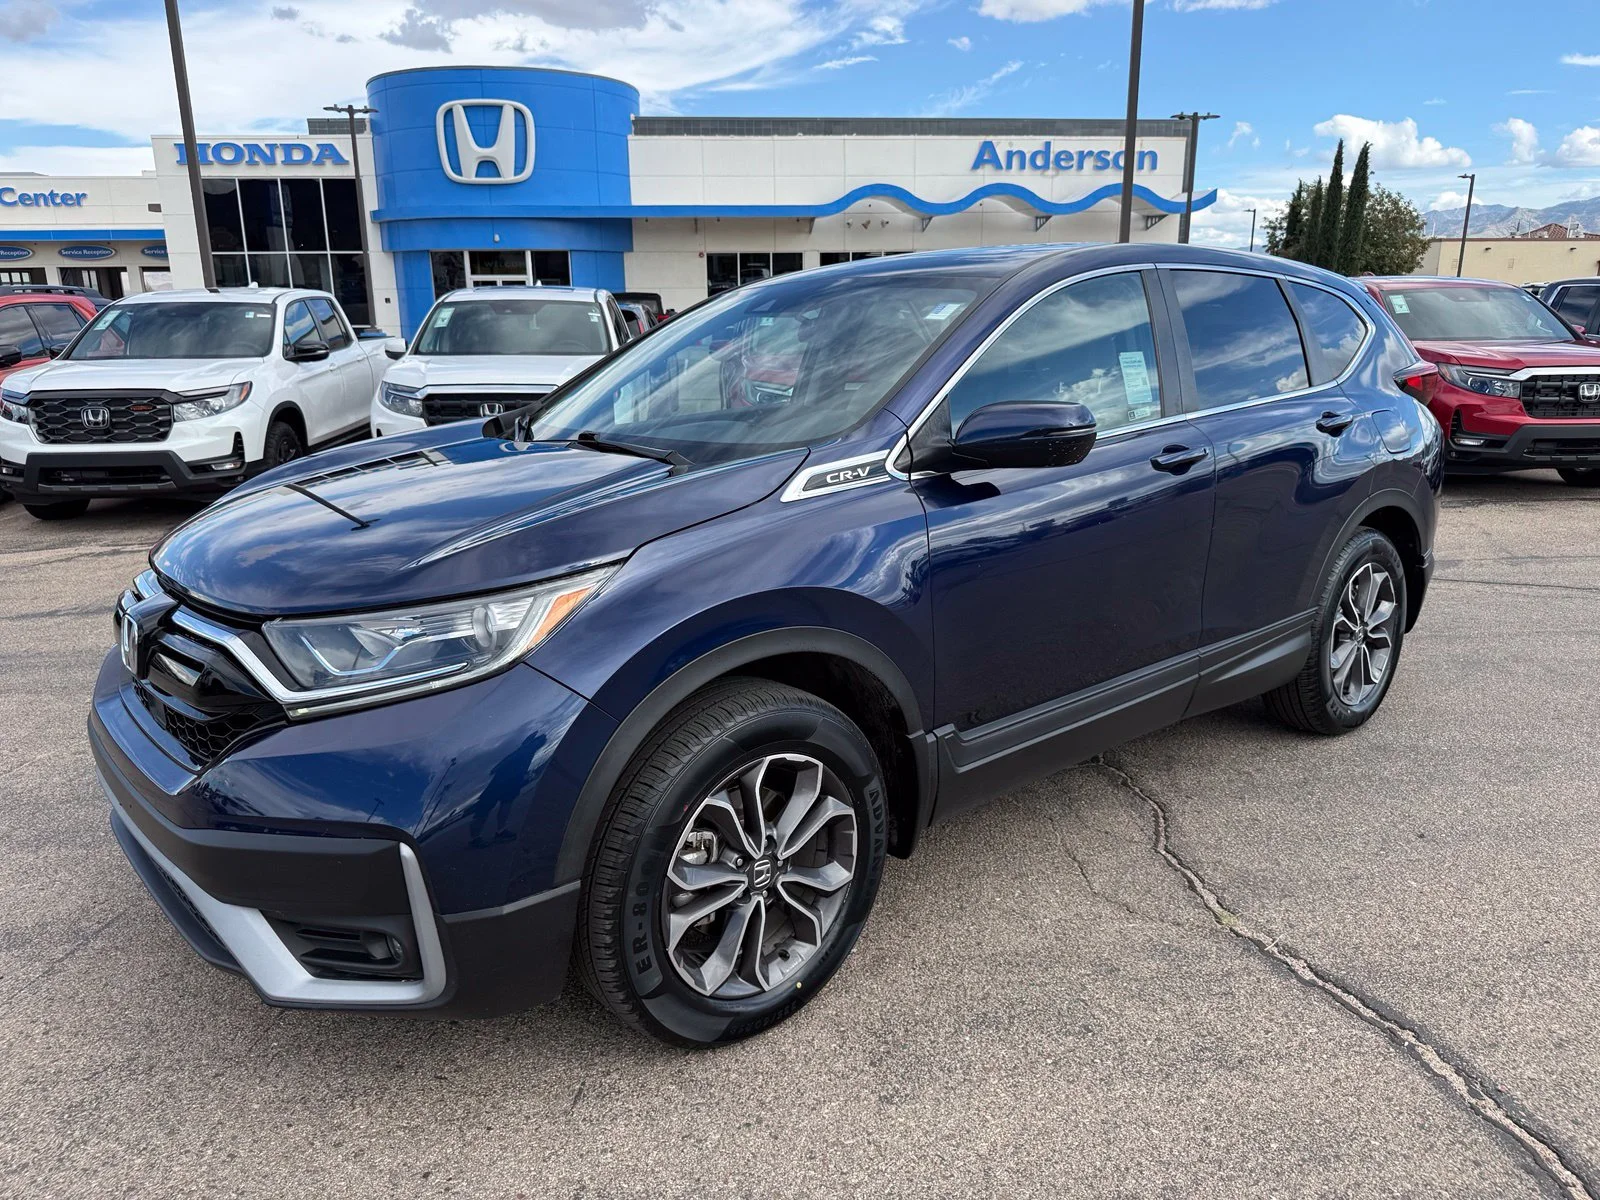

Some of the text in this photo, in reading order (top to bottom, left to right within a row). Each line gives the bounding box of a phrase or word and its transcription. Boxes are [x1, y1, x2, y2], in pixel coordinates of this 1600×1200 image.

[174, 142, 349, 165] HONDA
[970, 141, 1158, 171] Anderson
[0, 187, 87, 207] Center
[826, 466, 870, 483] CR-V
